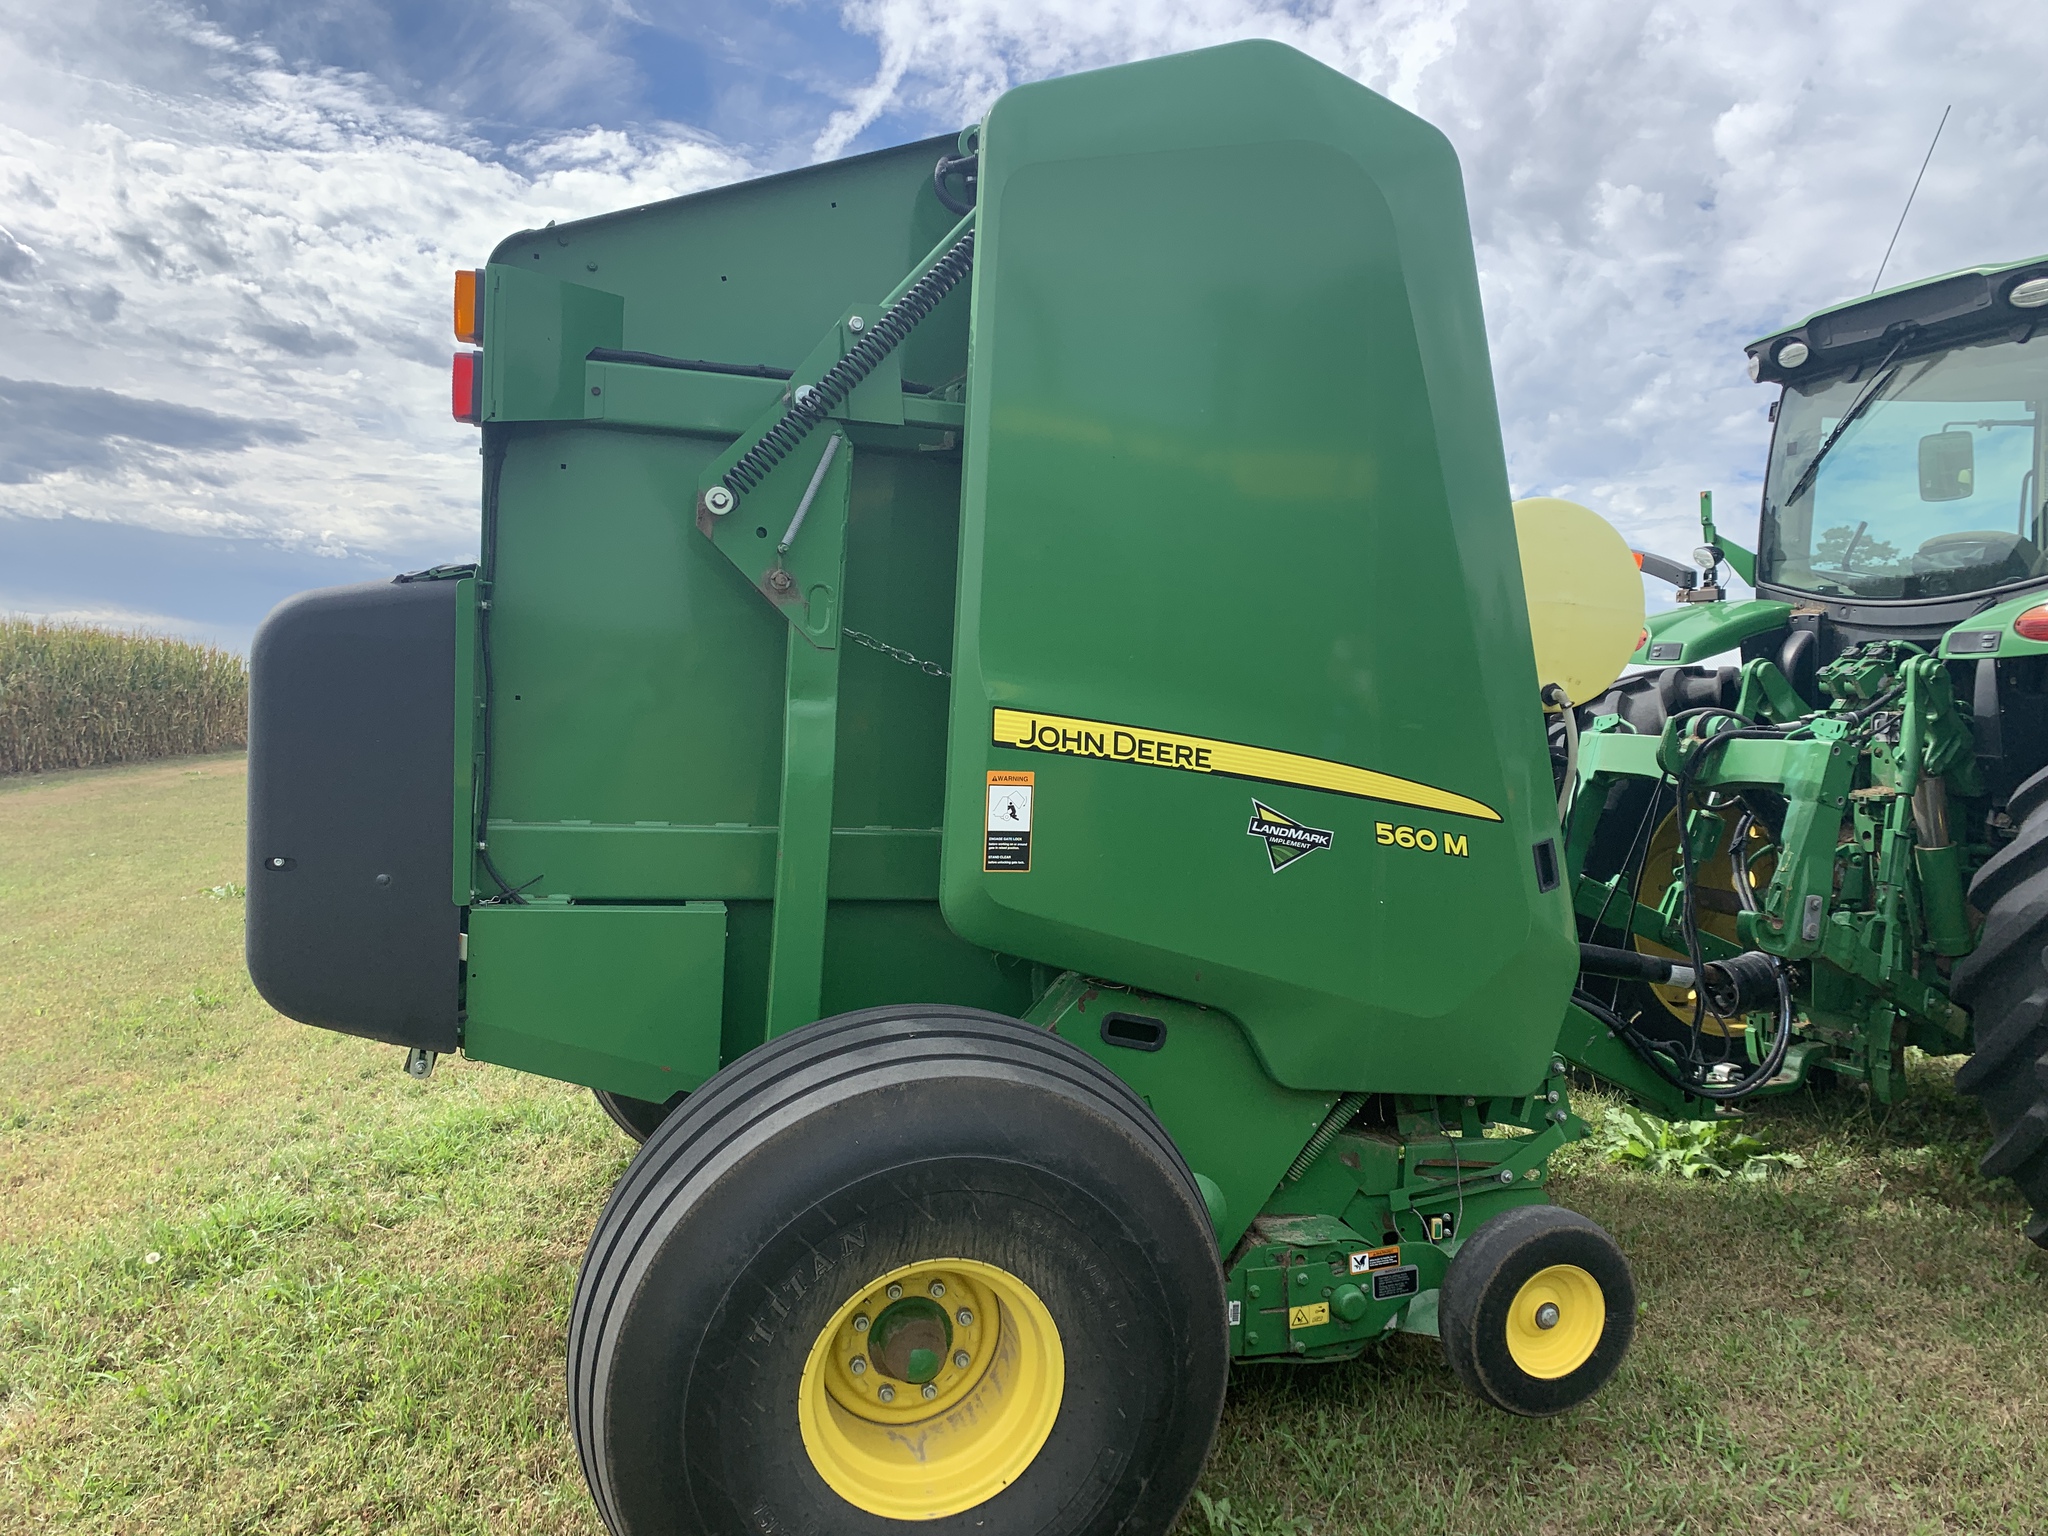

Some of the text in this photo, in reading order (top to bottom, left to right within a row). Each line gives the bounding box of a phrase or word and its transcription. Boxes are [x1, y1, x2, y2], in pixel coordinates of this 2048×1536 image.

[1019, 719, 1212, 769] JOHN DEERE
[1251, 821, 1330, 846] LANDMARK
[1269, 836, 1312, 850] IMPLEMENT
[1375, 820, 1470, 858] 560 M
[747, 1221, 868, 1348] TITAN
